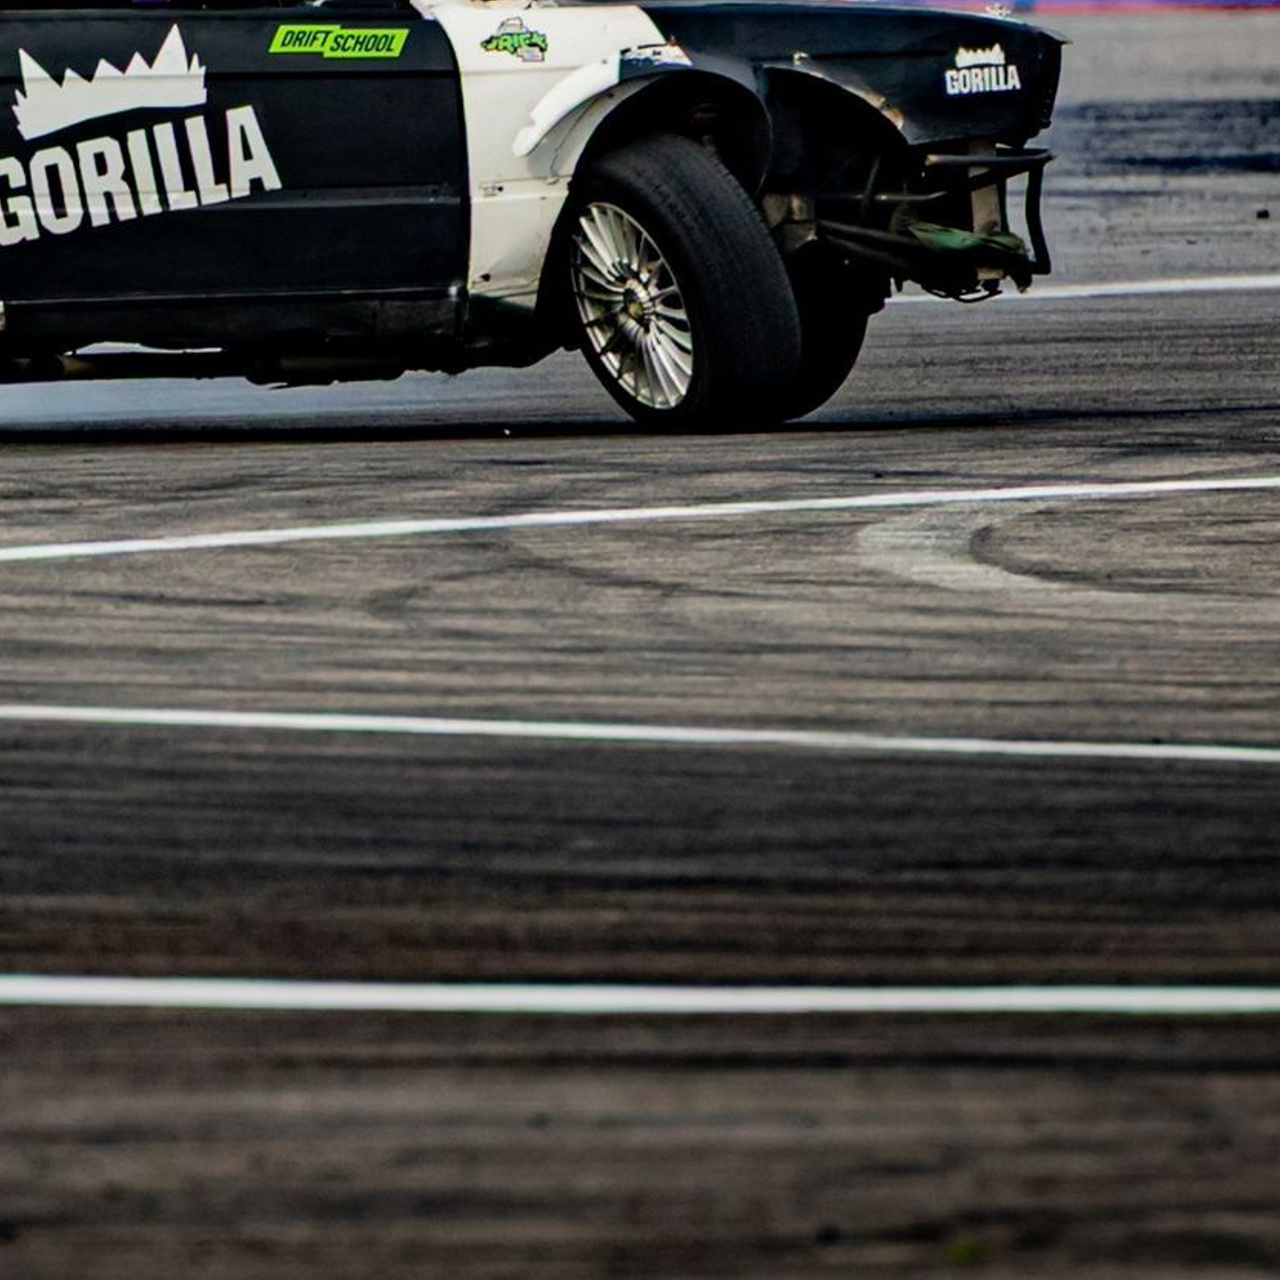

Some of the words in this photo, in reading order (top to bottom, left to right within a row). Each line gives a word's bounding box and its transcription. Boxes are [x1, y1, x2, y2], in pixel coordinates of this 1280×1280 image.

[280, 30, 333, 48] DRIFT
[329, 34, 397, 53] SCHOOL
[945, 65, 1021, 95] GORILLA
